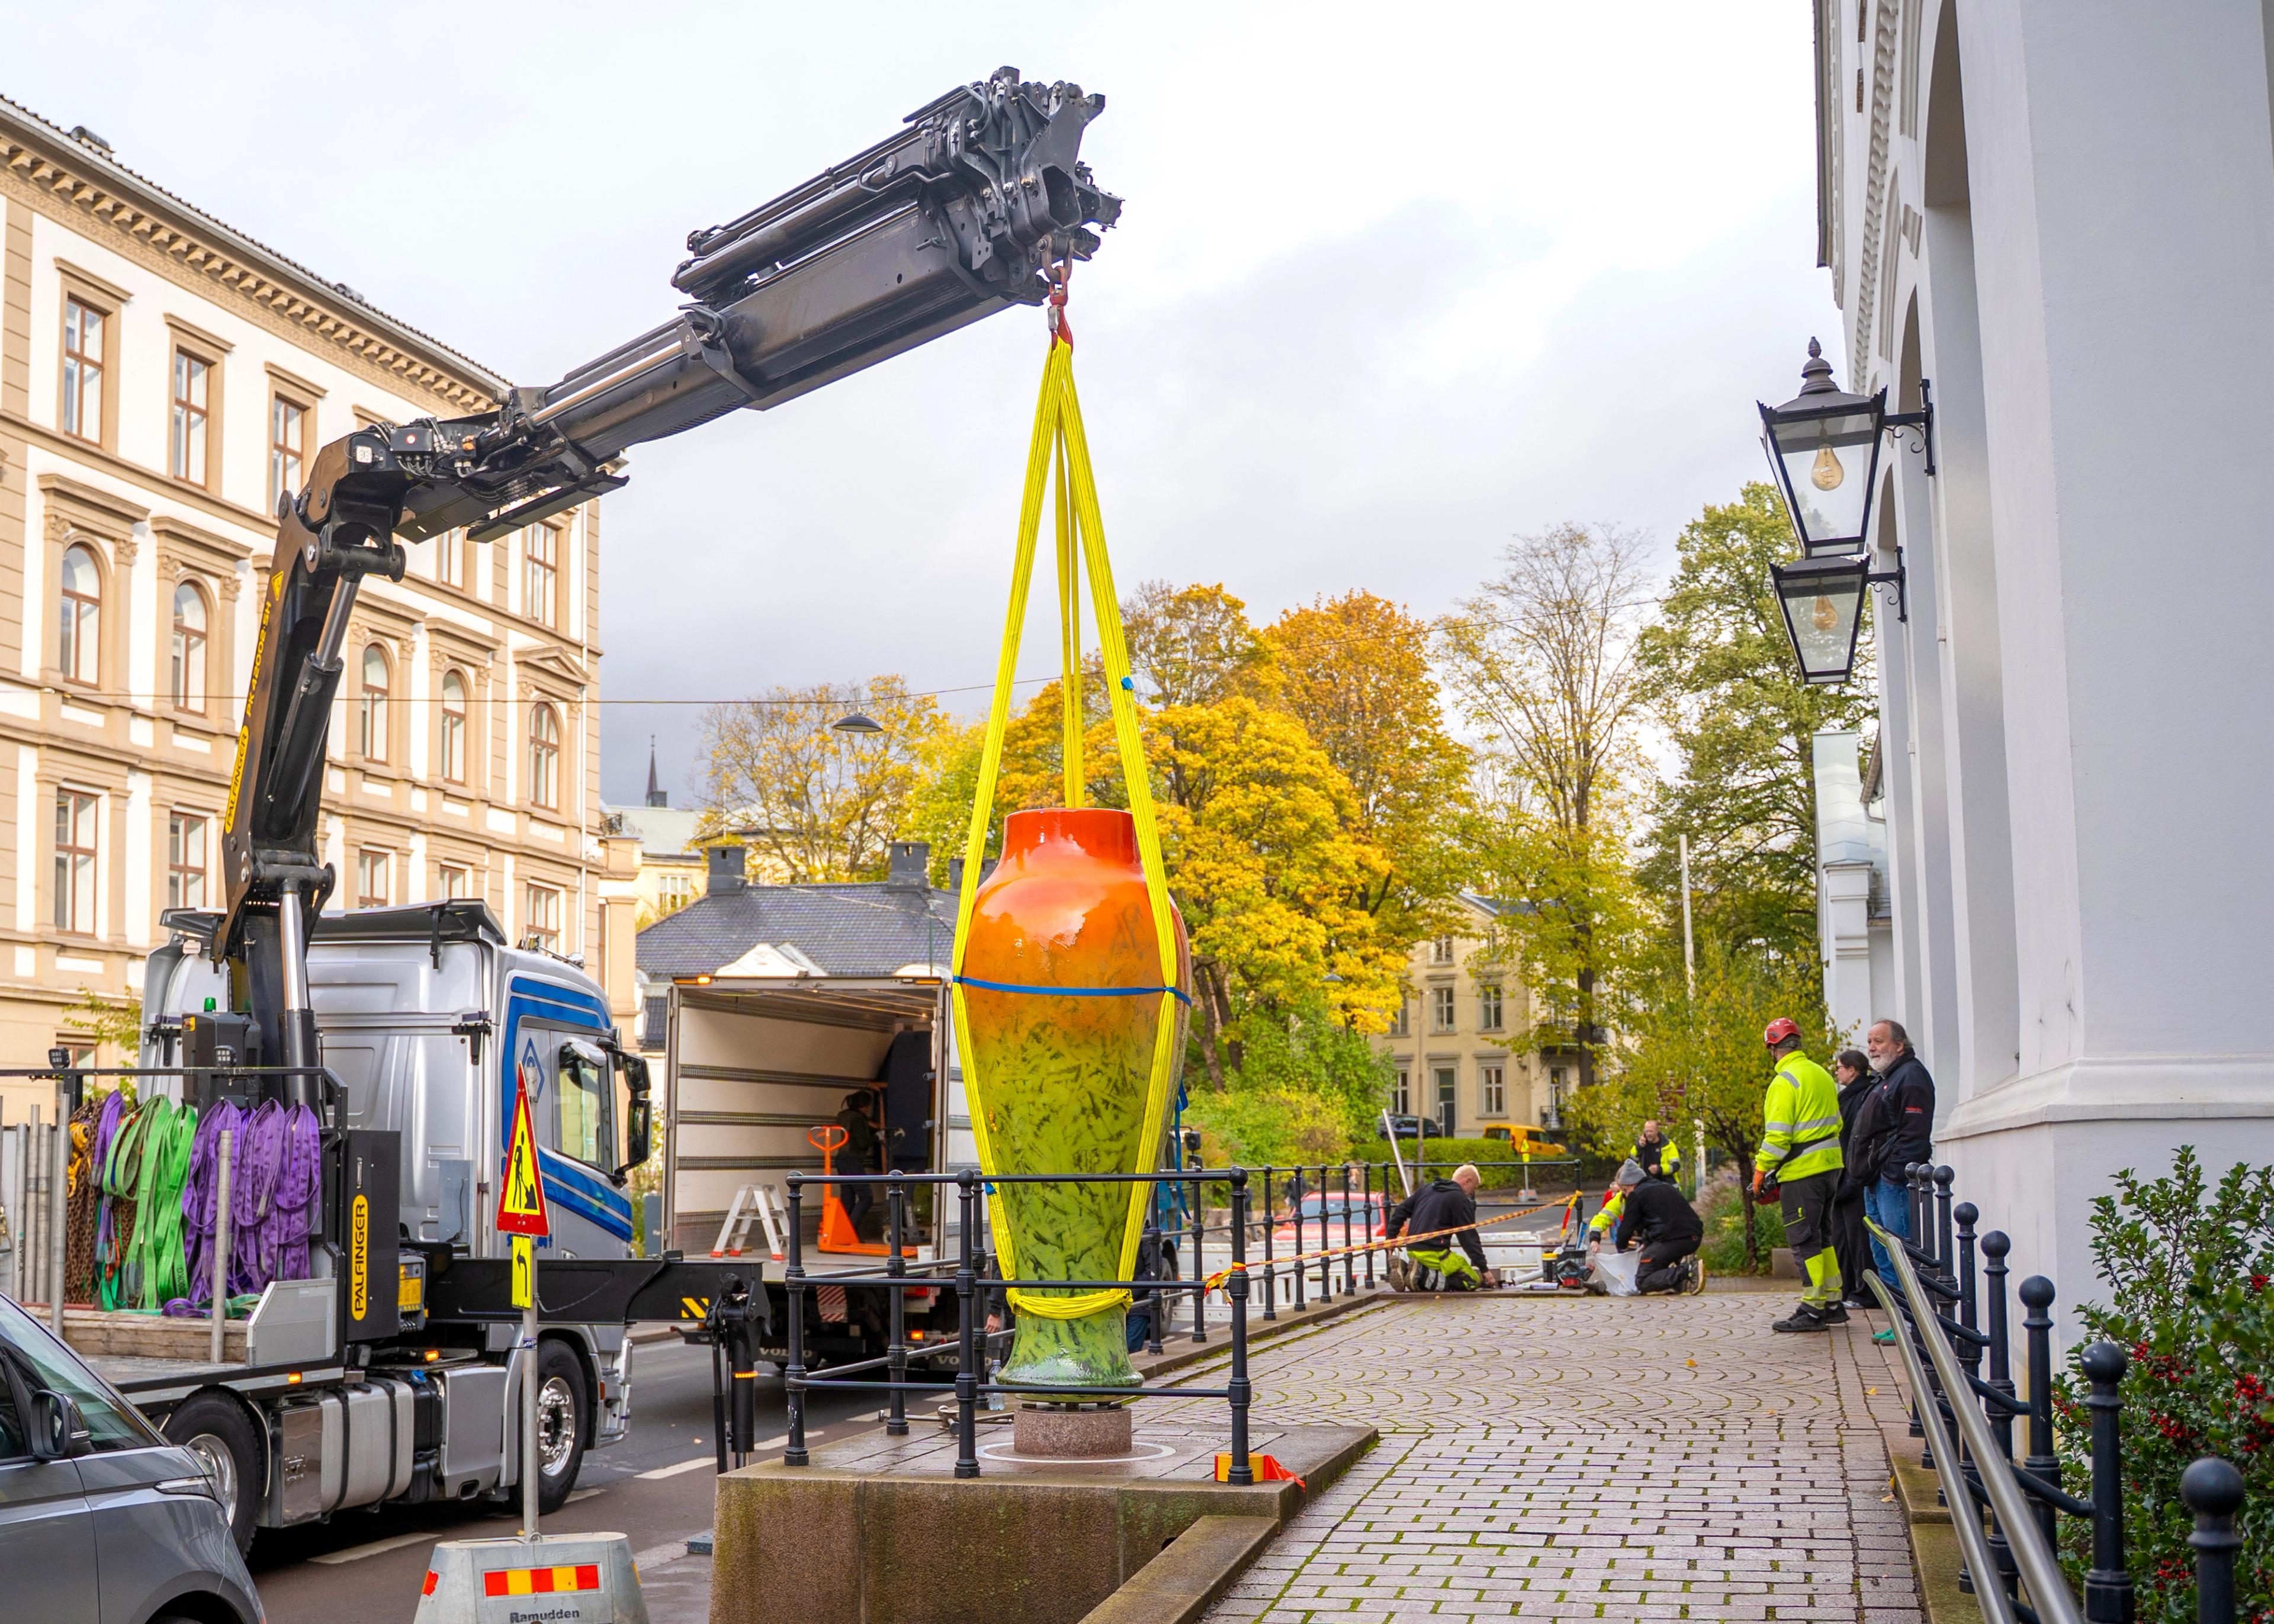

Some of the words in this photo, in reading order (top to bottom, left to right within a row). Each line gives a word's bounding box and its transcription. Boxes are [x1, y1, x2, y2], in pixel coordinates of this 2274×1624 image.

[246, 692, 255, 718] PK
[227, 733, 248, 827] PALFINGER
[355, 1204, 365, 1311] PALFINGER
[759, 1347, 813, 1358] VOLO
[935, 1355, 993, 1366] VOO
[510, 1609, 580, 1624] Ramudden
